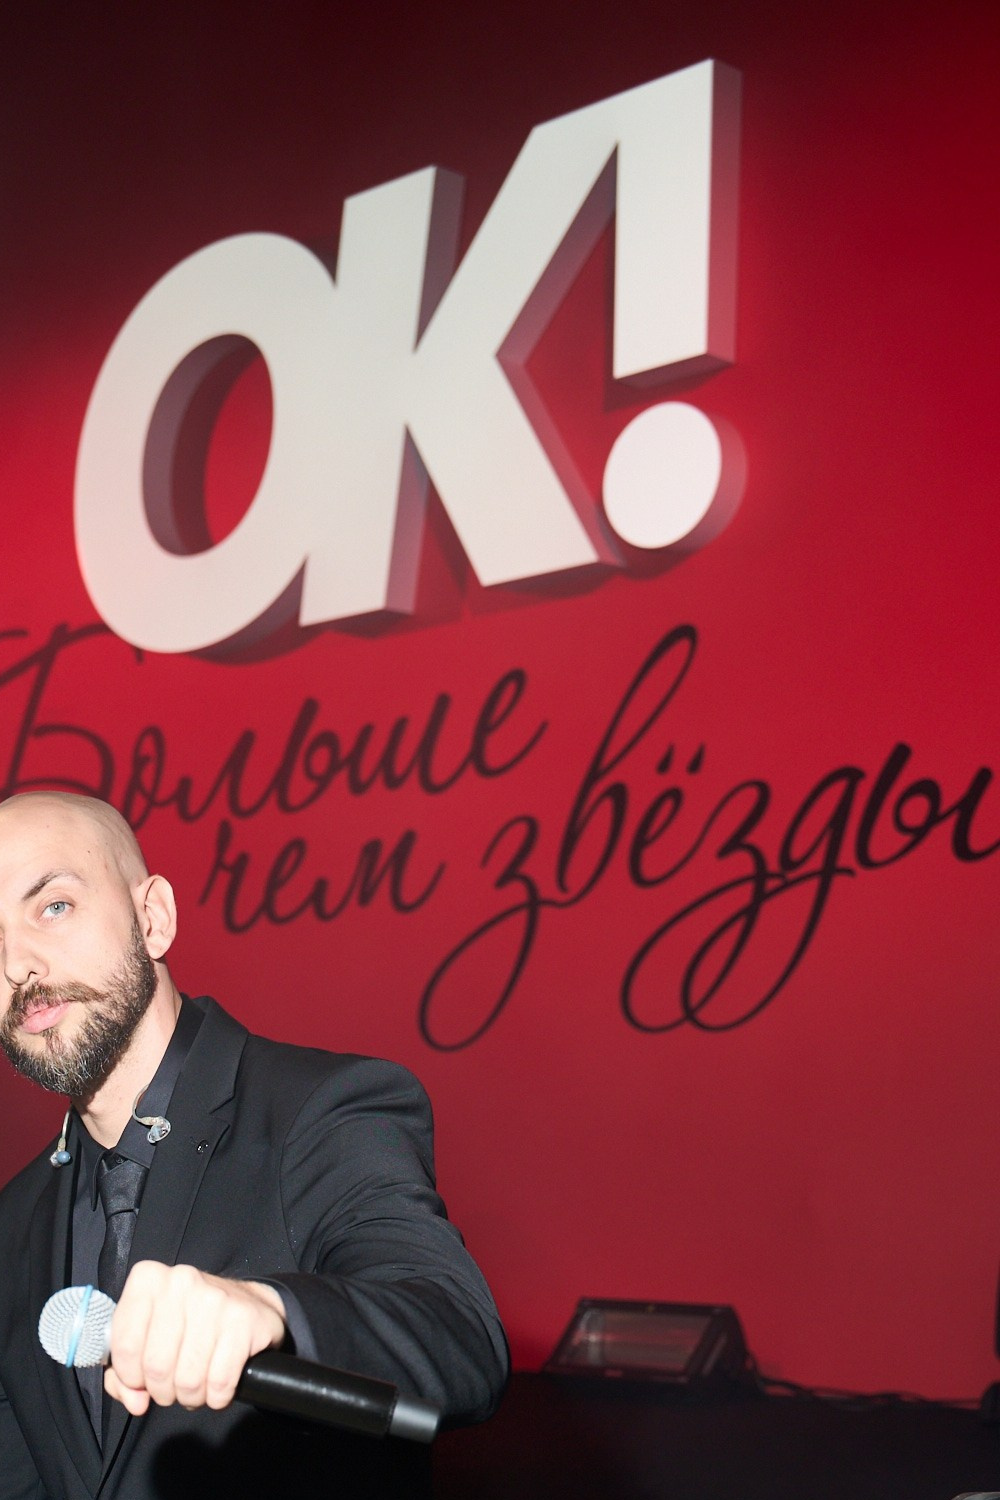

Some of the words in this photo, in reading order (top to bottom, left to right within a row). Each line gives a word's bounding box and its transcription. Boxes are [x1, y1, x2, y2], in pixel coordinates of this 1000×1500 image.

[73, 57, 742, 656] OK!
[197, 819, 446, 936] чем
[419, 624, 1000, 1052] звёзды
